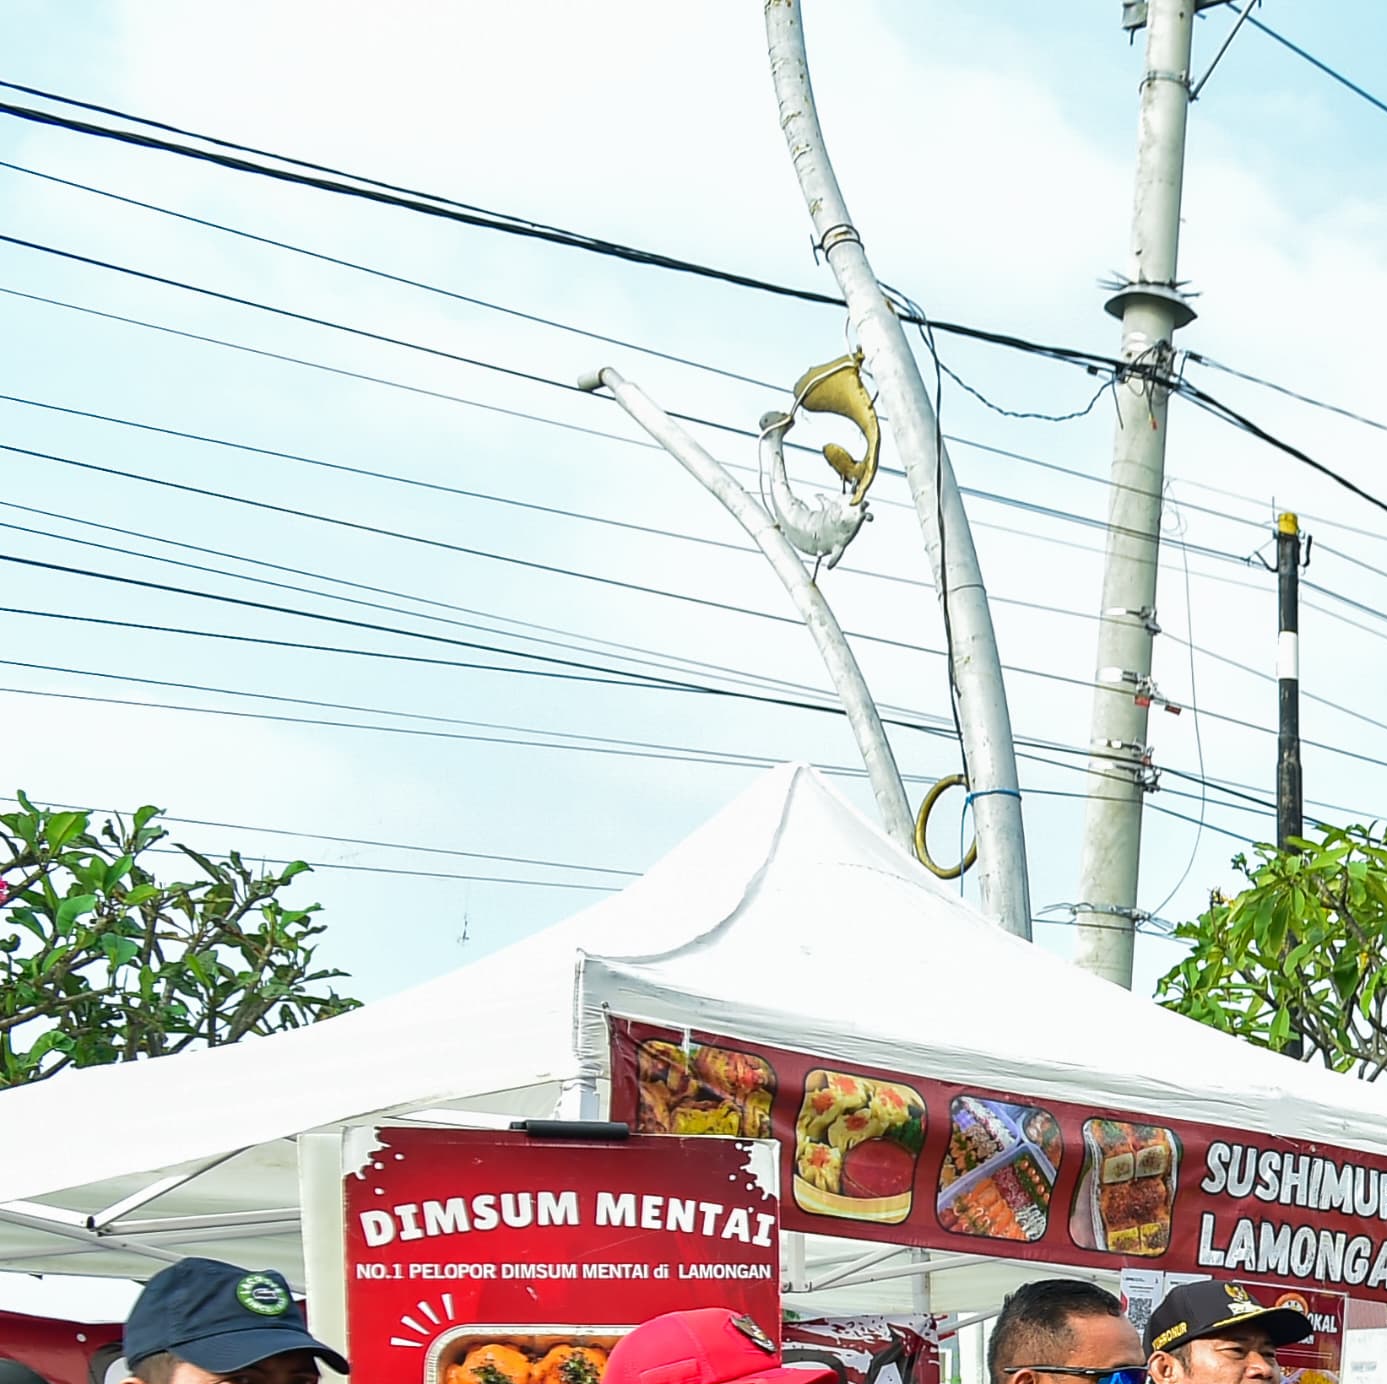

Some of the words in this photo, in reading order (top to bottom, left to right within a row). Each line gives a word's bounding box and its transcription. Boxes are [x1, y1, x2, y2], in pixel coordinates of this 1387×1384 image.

[359, 1191, 580, 1248] DIMSUM
[595, 1191, 776, 1248] MENTAI
[356, 1262, 403, 1280] NO.1
[409, 1262, 497, 1280] PELOPOR
[501, 1262, 578, 1280] DIMSUM
[582, 1262, 649, 1280] MENTAI
[653, 1262, 669, 1280] di
[678, 1262, 772, 1280] LAMONGAN
